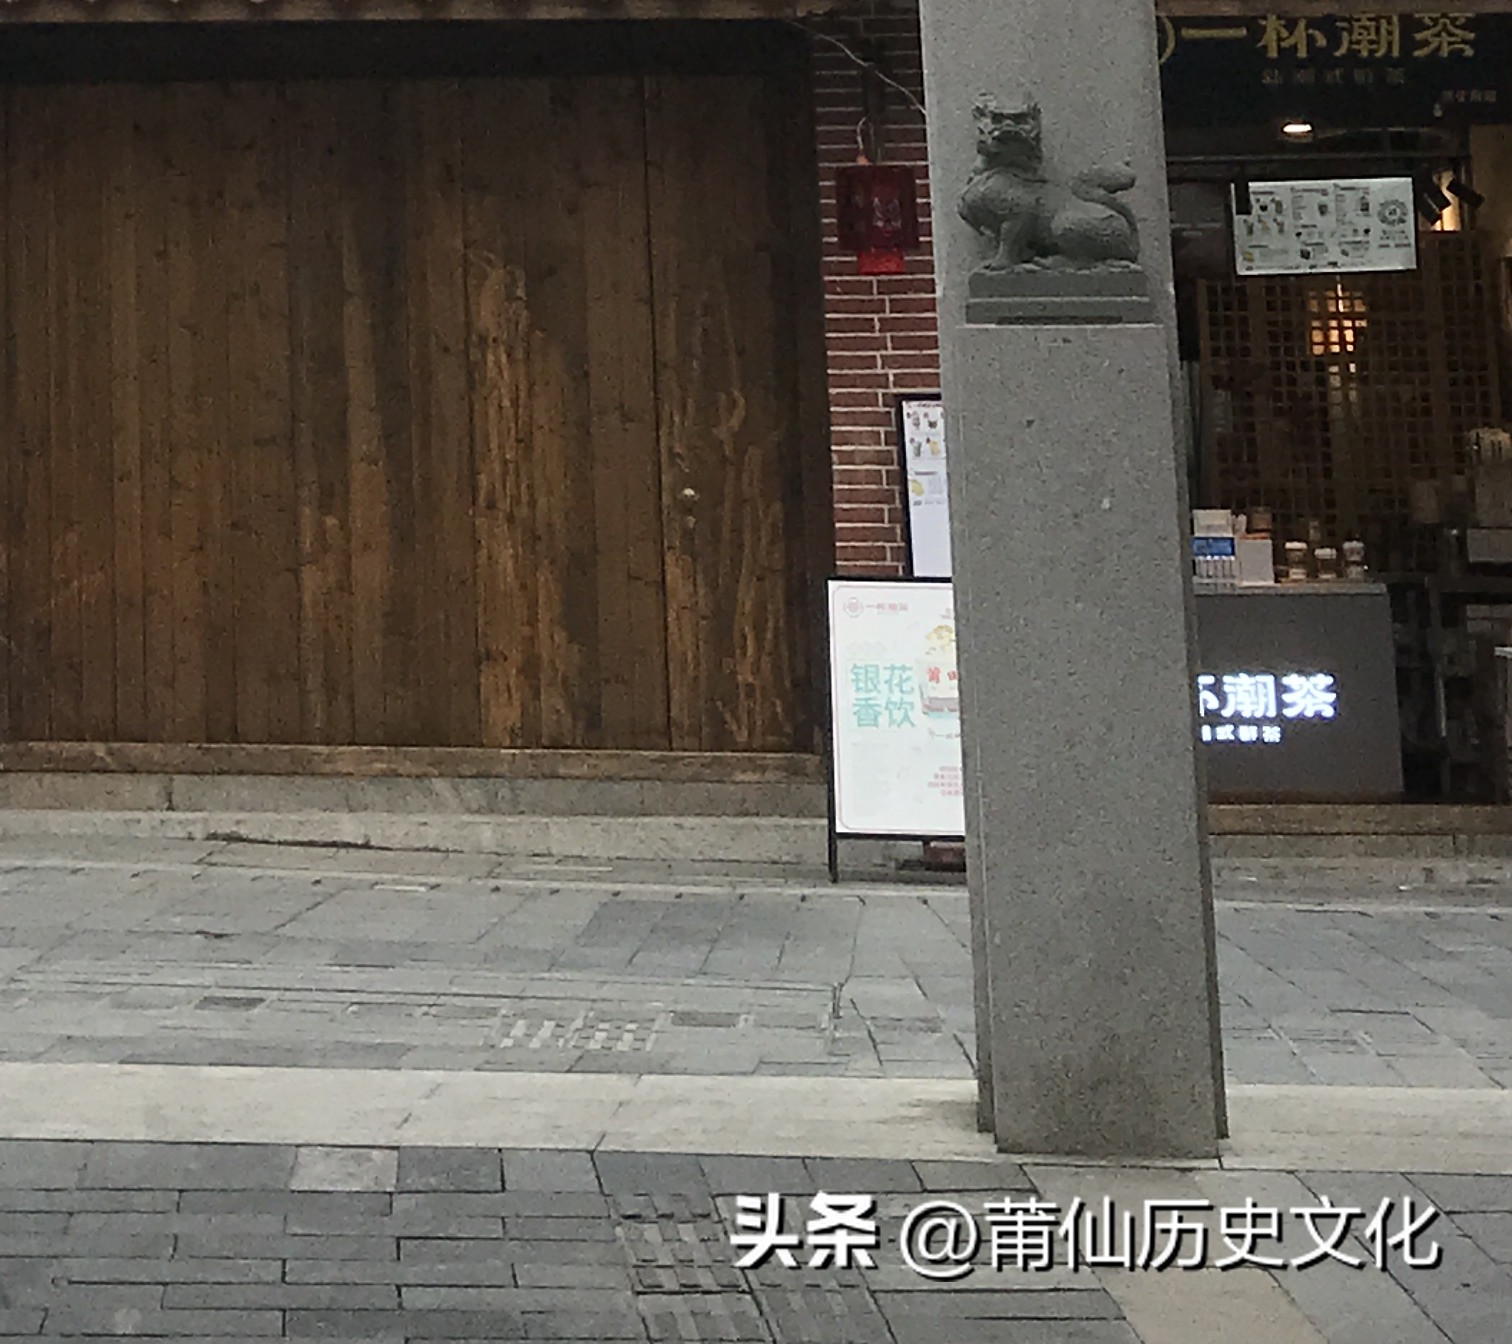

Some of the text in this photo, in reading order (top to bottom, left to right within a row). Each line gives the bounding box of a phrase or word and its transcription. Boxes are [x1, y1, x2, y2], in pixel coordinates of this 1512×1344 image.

[1180, 12, 1477, 58] 一杯潮茶
[850, 663, 915, 694] 银花
[852, 697, 917, 729] 香饮
